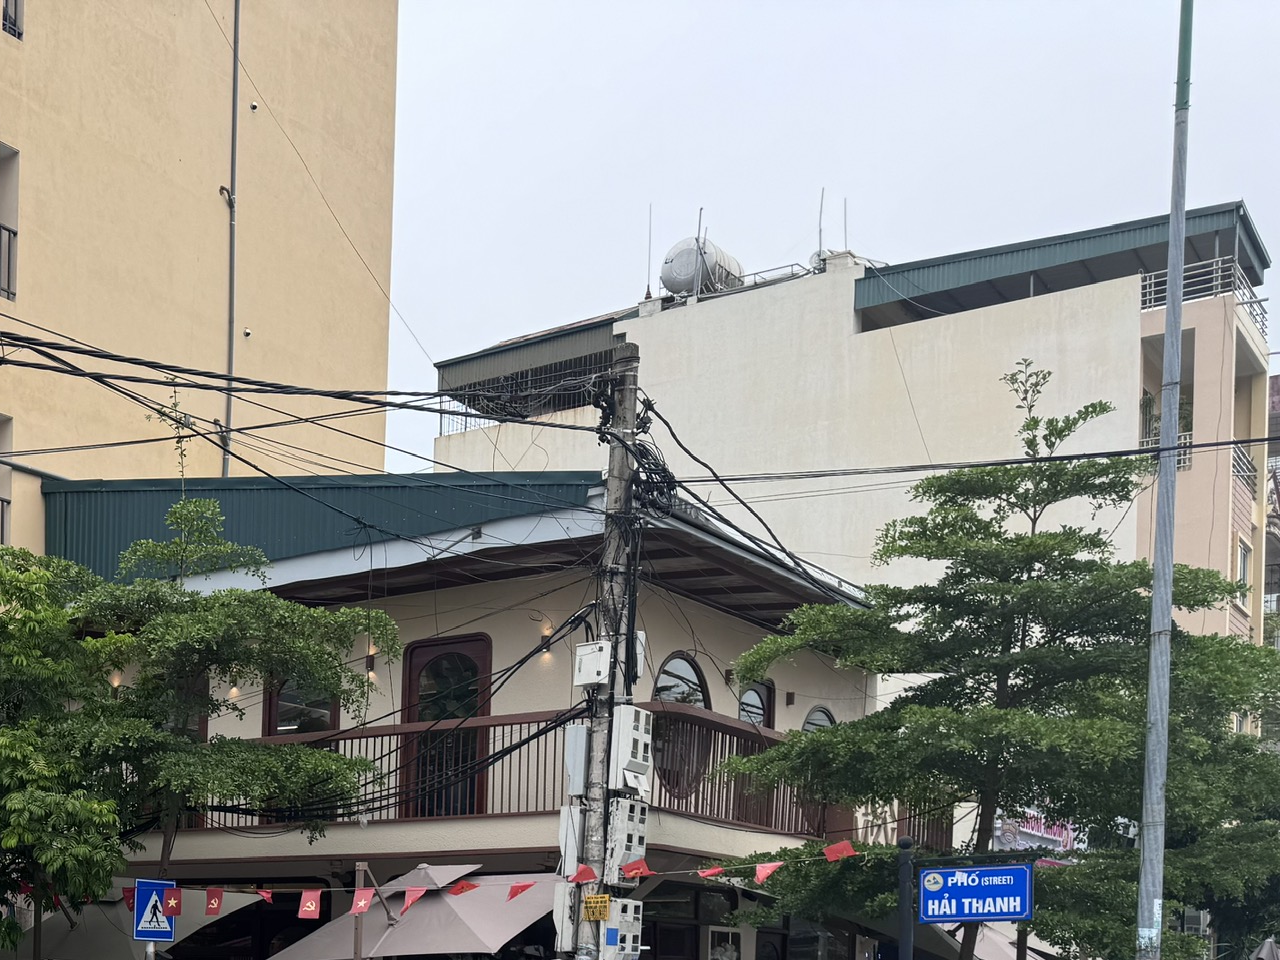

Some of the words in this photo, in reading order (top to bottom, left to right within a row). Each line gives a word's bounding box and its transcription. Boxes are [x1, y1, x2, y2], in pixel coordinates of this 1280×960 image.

[981, 876, 1014, 886] (STREET)
[928, 893, 956, 915] HẢI
[962, 896, 1021, 914] THANH
